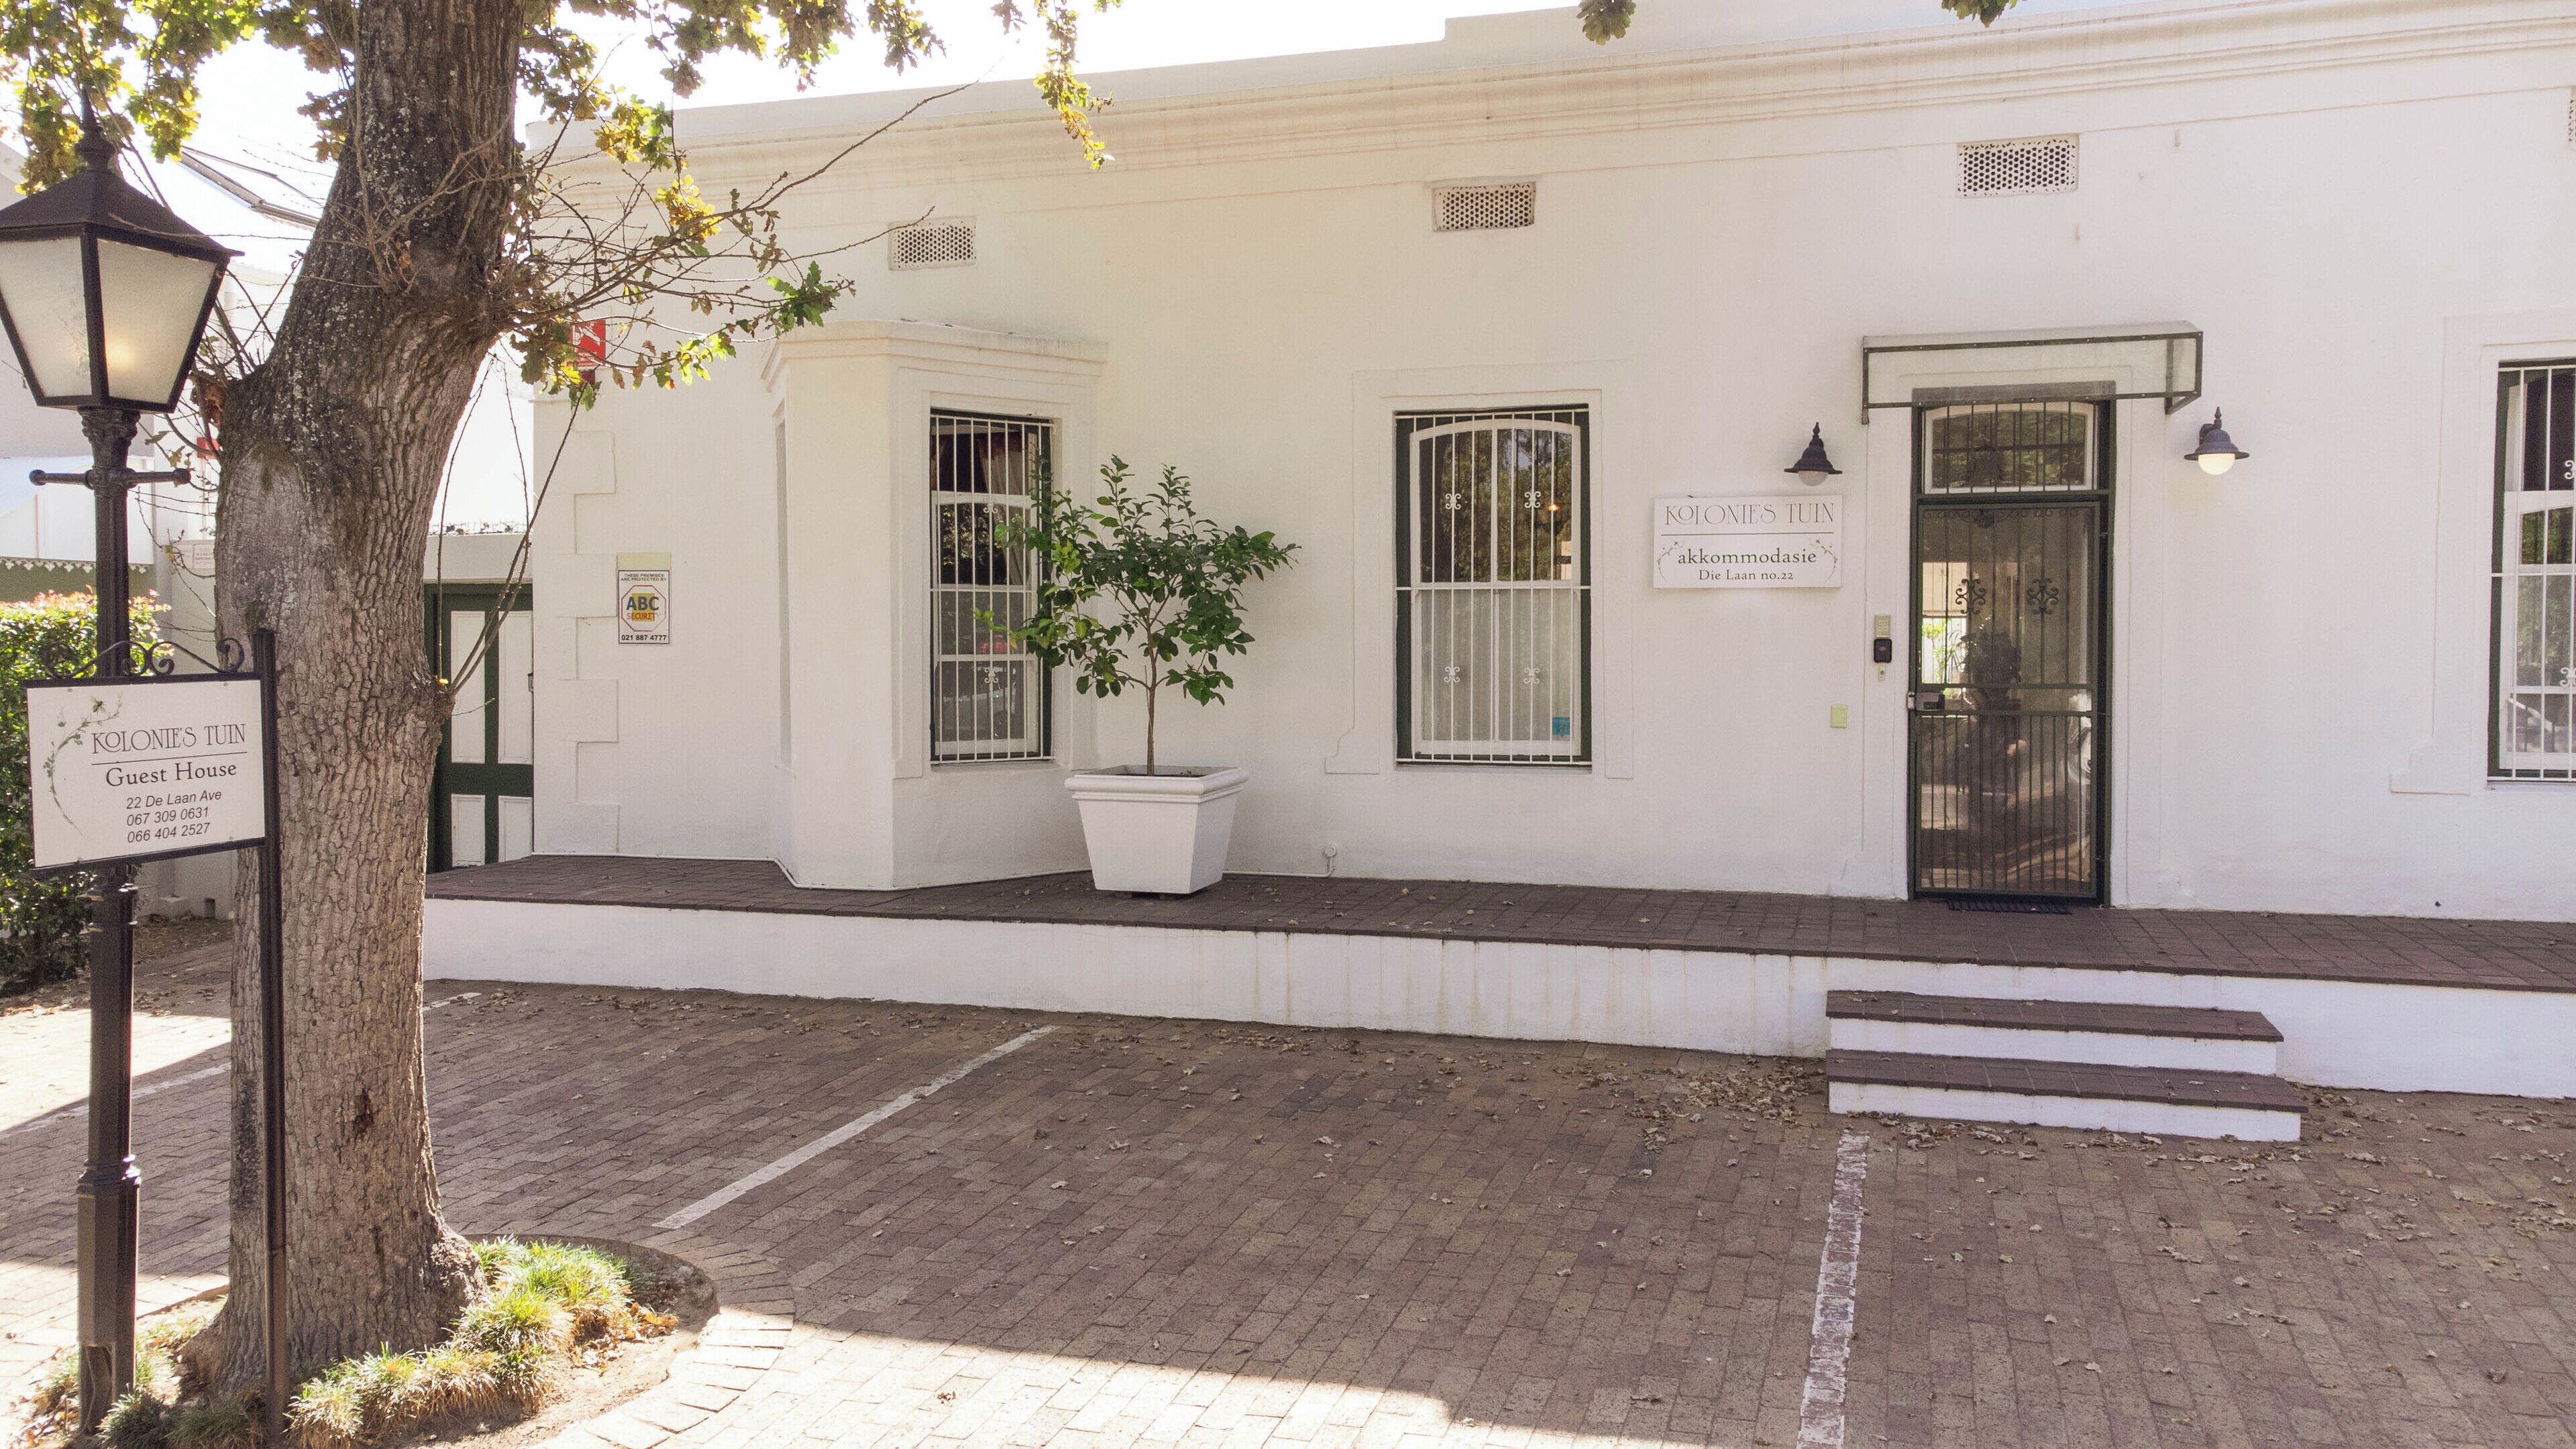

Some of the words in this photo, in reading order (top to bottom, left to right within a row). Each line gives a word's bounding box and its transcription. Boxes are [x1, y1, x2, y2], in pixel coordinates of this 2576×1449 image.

[1664, 504, 1776, 525] KOLONIE'S
[1785, 502, 1834, 523] TUIN
[1678, 547, 1817, 564] akkommodasie
[1699, 570, 1721, 581] Die
[1726, 570, 1756, 580] Laan
[627, 596, 659, 610] ABC
[92, 727, 197, 754] KOLONIE'S
[204, 723, 247, 746] TUIN
[105, 767, 167, 787] Guest
[174, 761, 237, 780] House
[126, 796, 142, 809] 22
[146, 795, 162, 807] De
[167, 794, 197, 805] Laan
[199, 790, 222, 802] Ave
[127, 812, 150, 826] 067
[154, 810, 176, 823] 309
[180, 806, 209, 820] 0631
[127, 829, 150, 843] 066
[155, 826, 177, 839] 404
[181, 822, 211, 837] 2527
